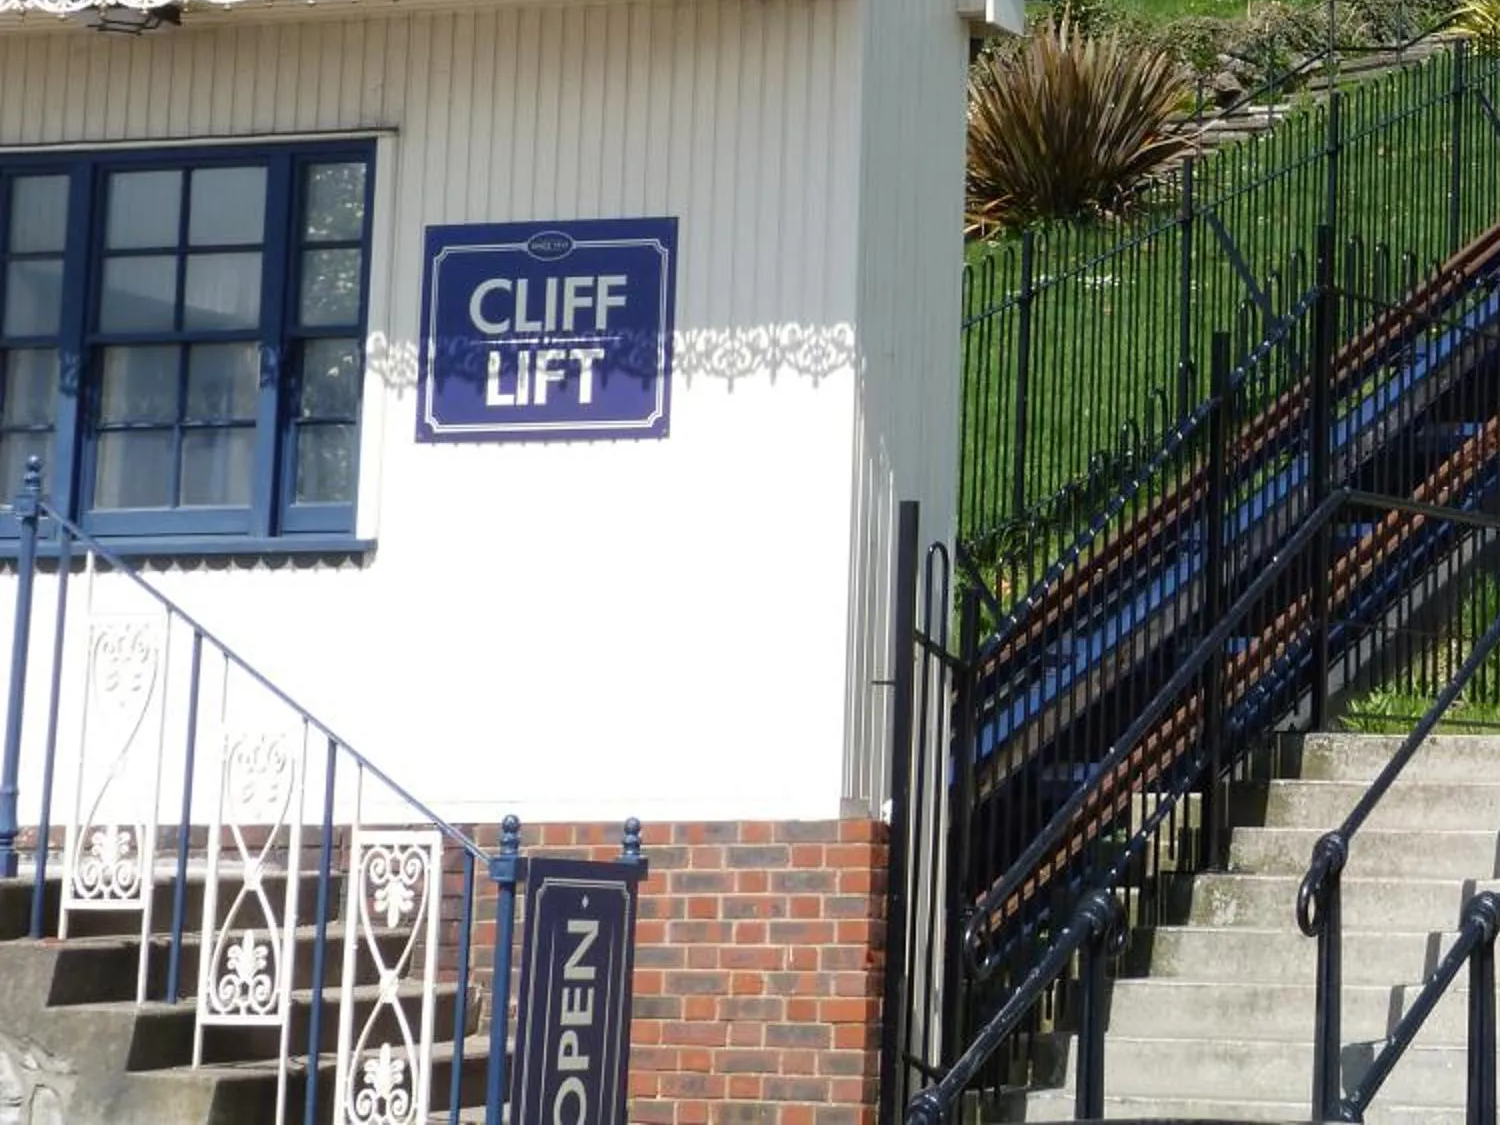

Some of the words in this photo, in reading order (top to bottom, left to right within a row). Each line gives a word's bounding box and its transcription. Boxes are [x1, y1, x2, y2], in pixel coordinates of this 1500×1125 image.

[469, 274, 627, 334] CLIFF
[486, 348, 605, 406] LIFT
[553, 919, 599, 1125] OPEN
